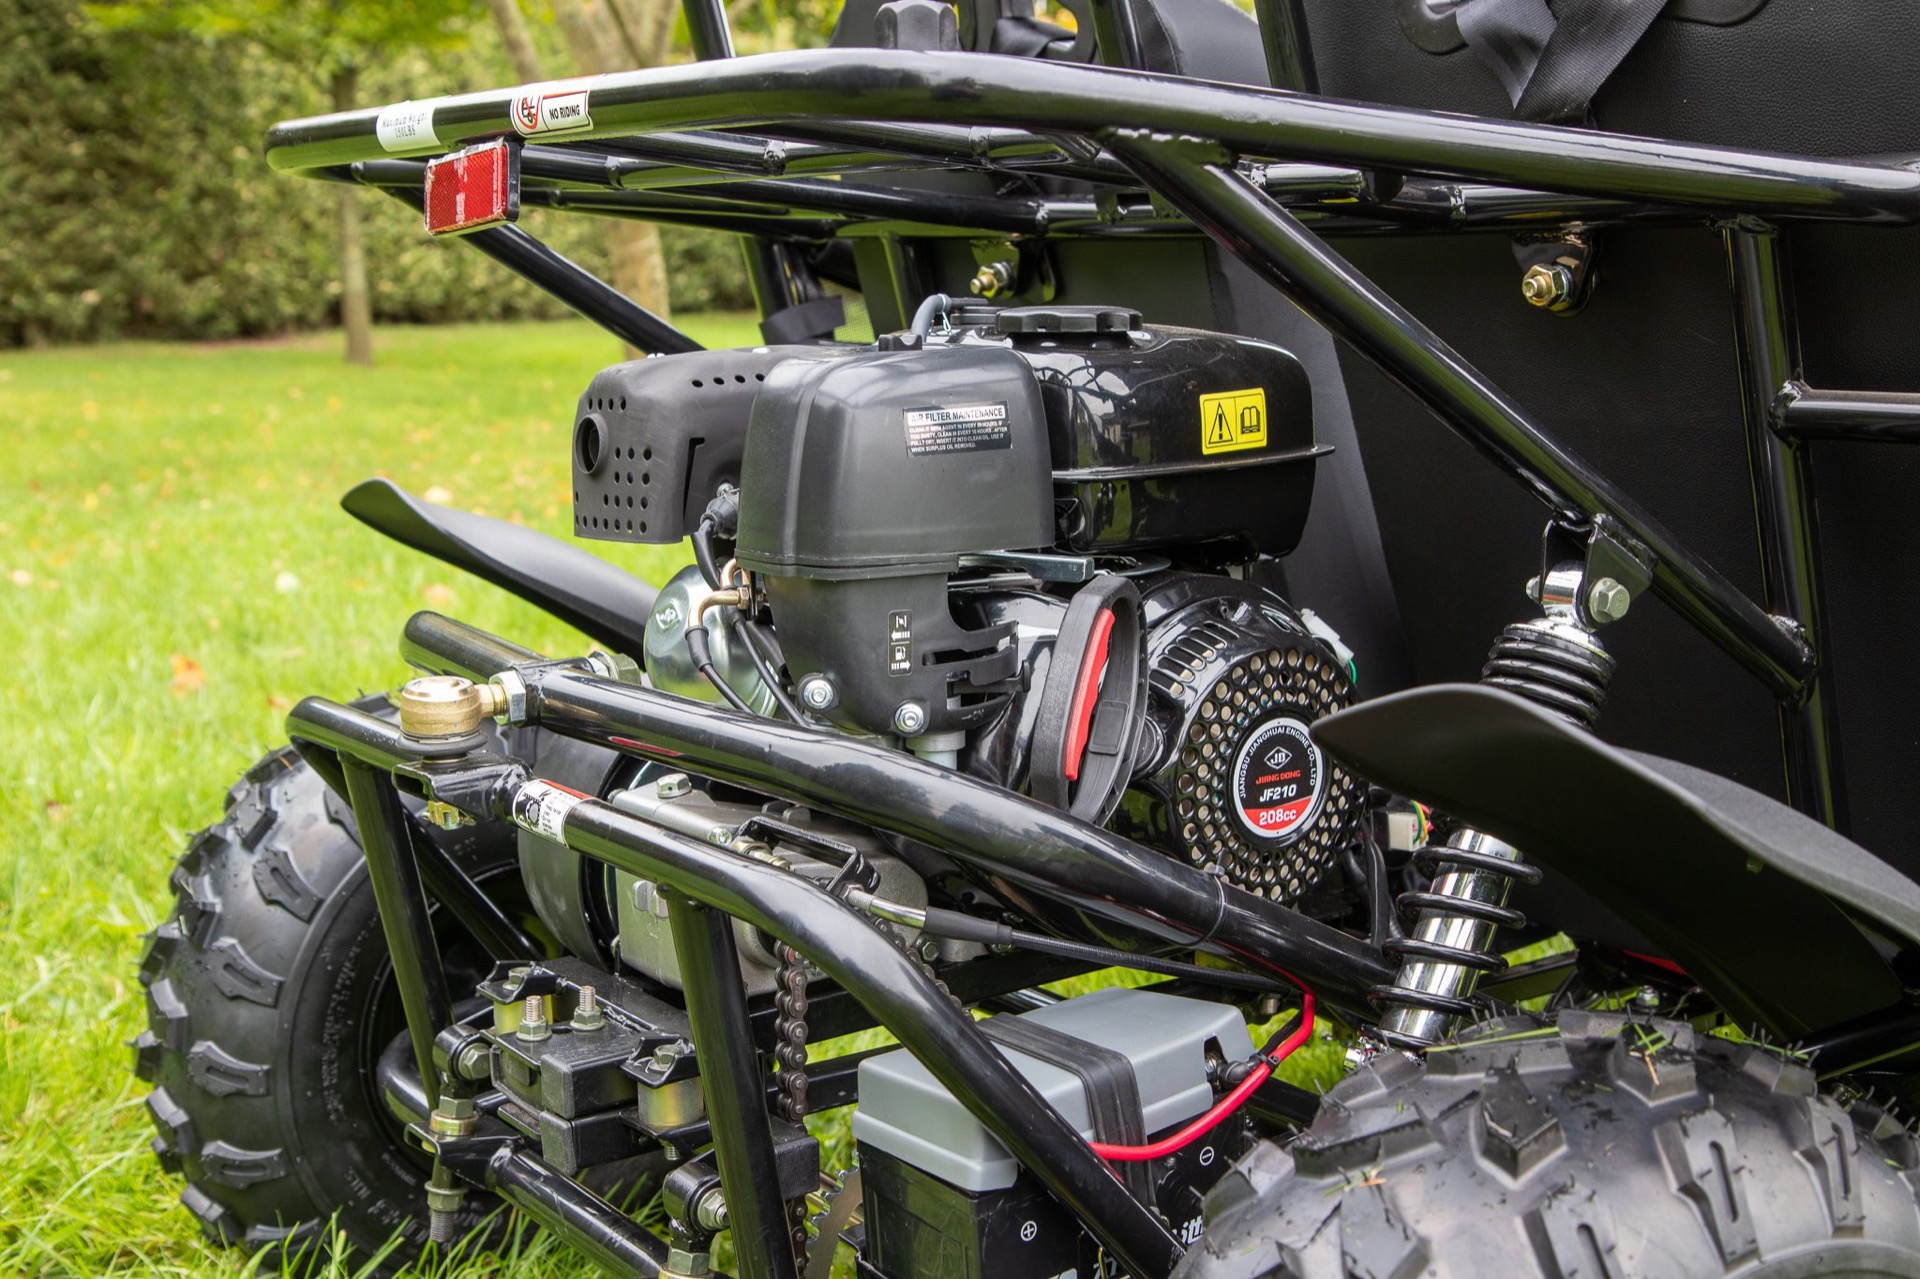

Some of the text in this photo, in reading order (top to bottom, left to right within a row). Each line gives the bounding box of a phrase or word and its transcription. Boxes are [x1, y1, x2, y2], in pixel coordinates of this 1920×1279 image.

[549, 105, 580, 120] NO RIDING
[911, 407, 1003, 422] AIR FILTER MAINTENANCE
[1239, 757, 1250, 798] JIANGSU
[1249, 727, 1285, 756] JIANGHUAI
[1286, 726, 1310, 749] ENGINE
[1280, 769, 1301, 780] DONG
[1259, 784, 1297, 802] JF210
[1259, 808, 1297, 826] 208cc
